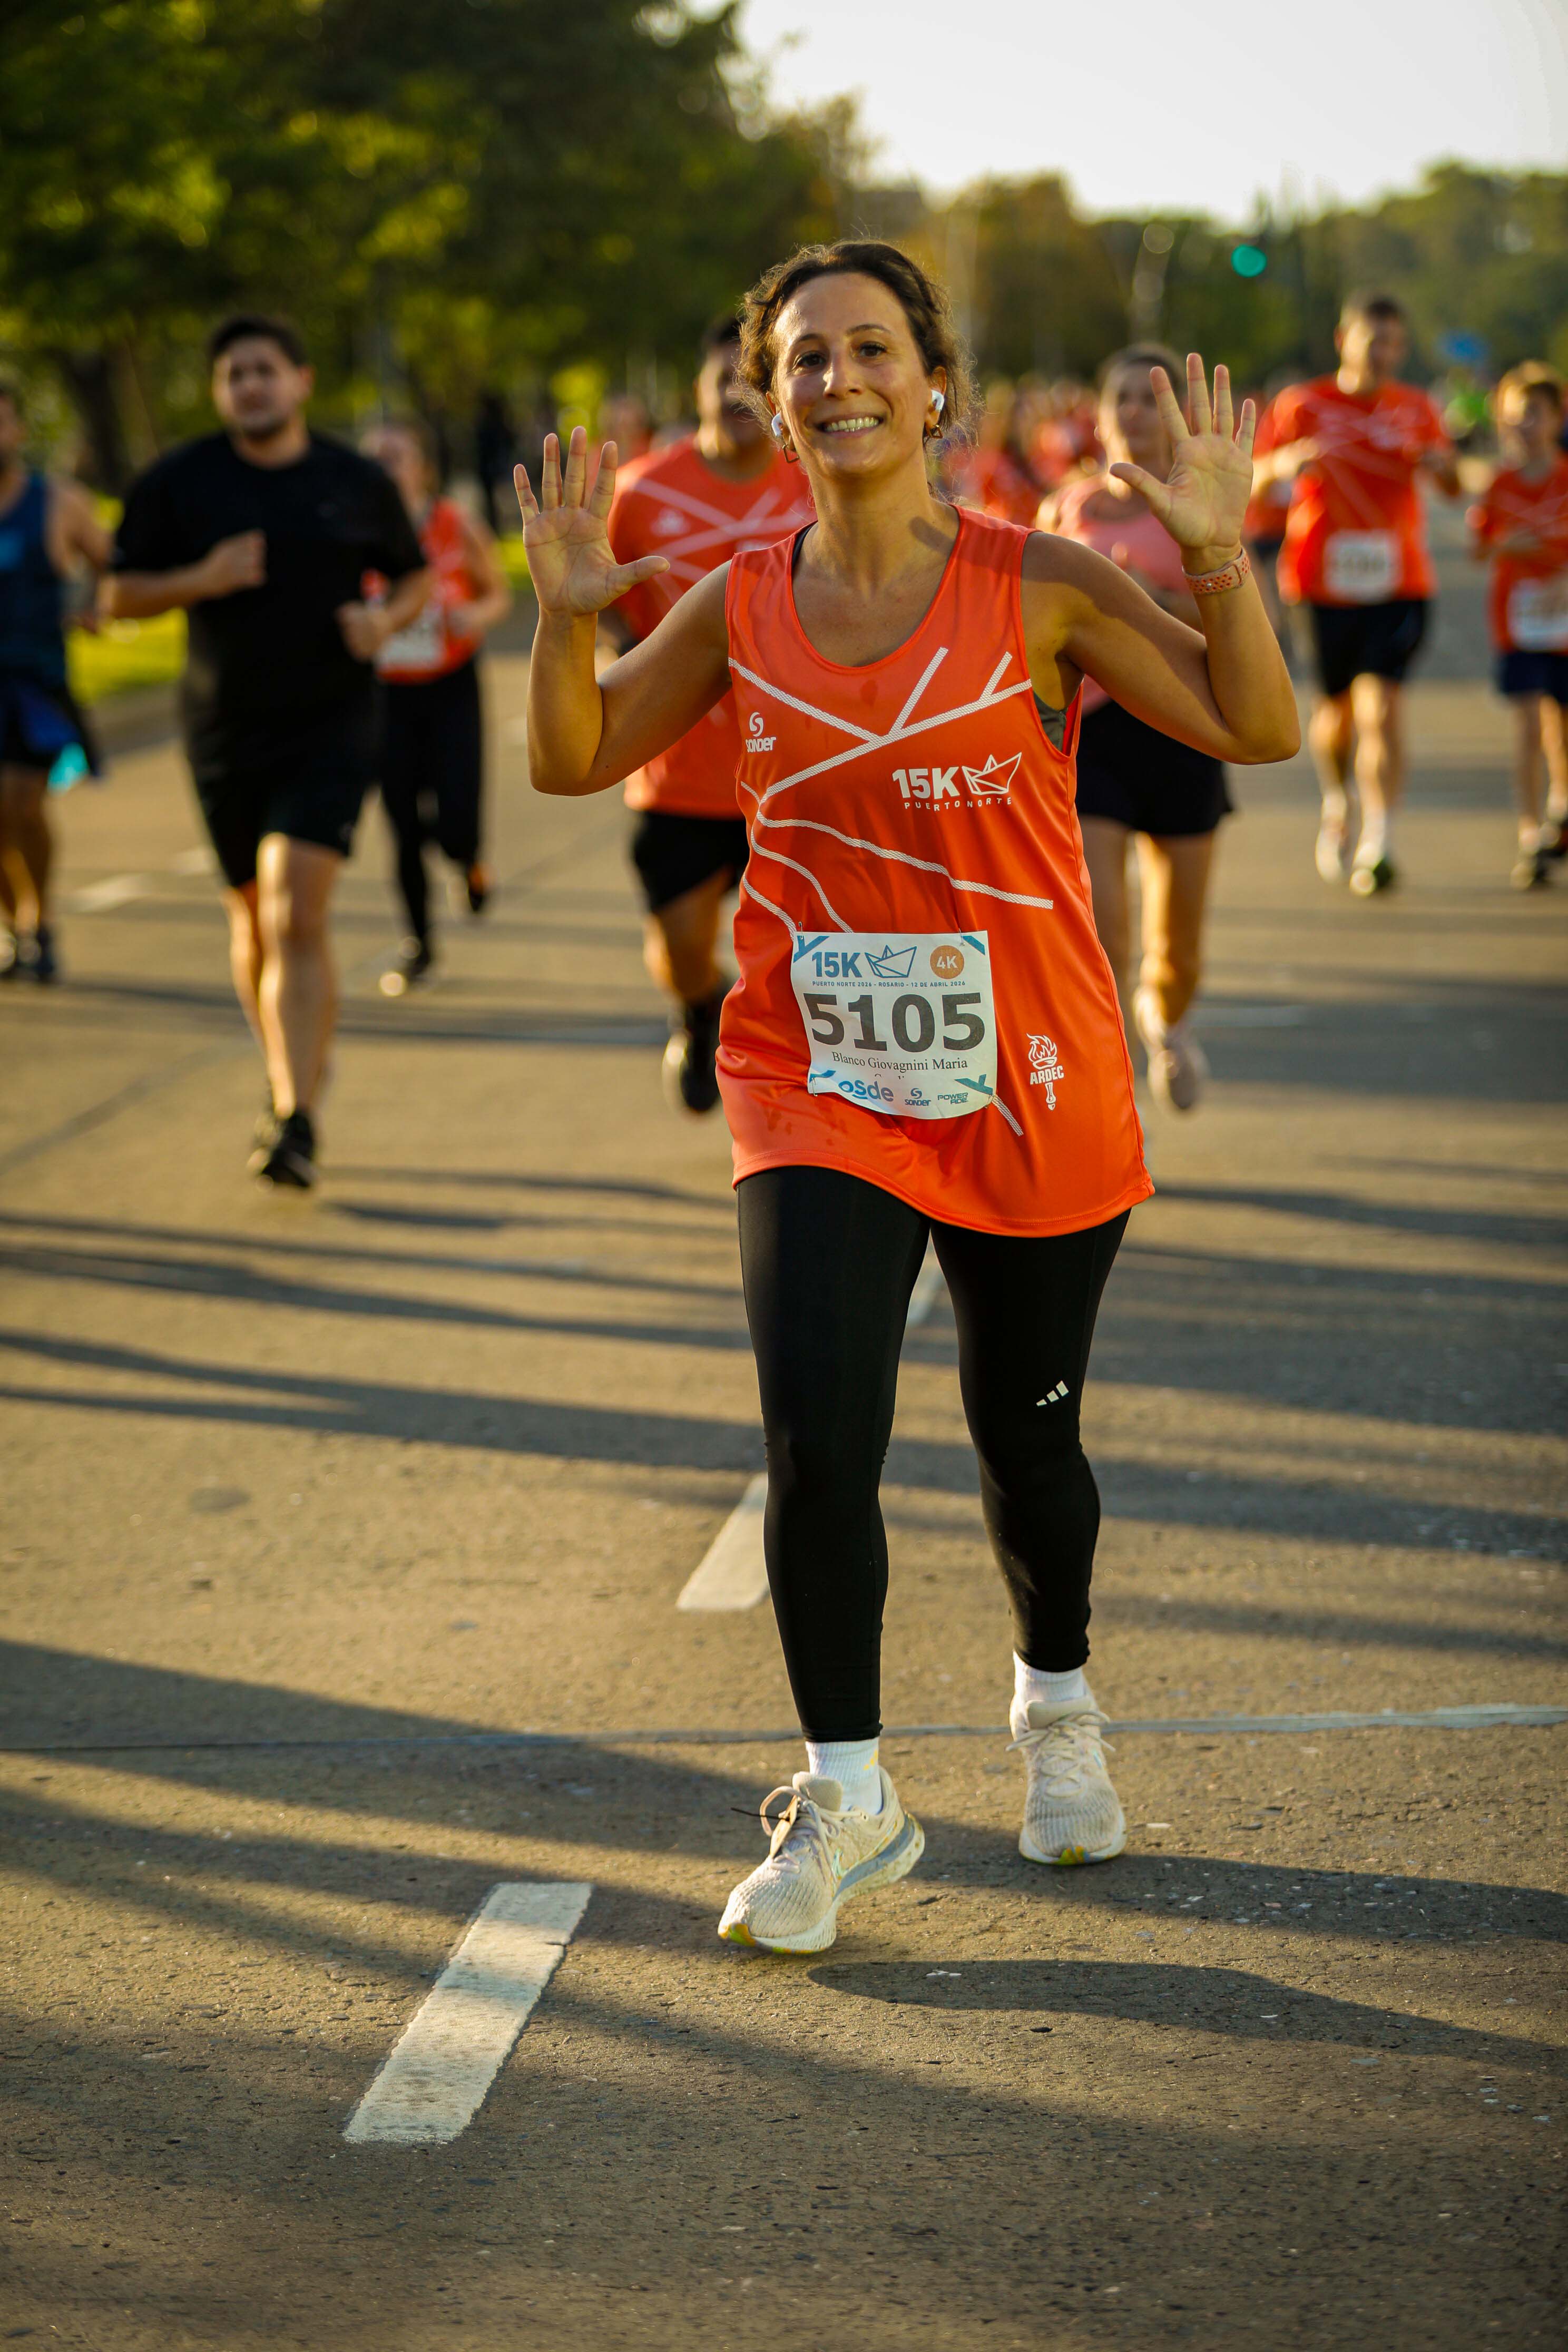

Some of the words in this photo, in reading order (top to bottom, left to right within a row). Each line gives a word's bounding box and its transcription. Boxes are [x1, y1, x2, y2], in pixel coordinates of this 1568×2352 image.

[892, 766, 960, 799] 15K
[812, 952, 863, 977] 15K
[936, 955, 957, 969] 4K
[803, 992, 985, 1053] 5105
[832, 1051, 866, 1066] Blanco
[868, 1057, 928, 1073] Giovagnini
[932, 1057, 968, 1070] Maria
[1030, 1065, 1064, 1085] ARDEC
[838, 1080, 894, 1102] osde
[937, 1092, 968, 1101] POWER
